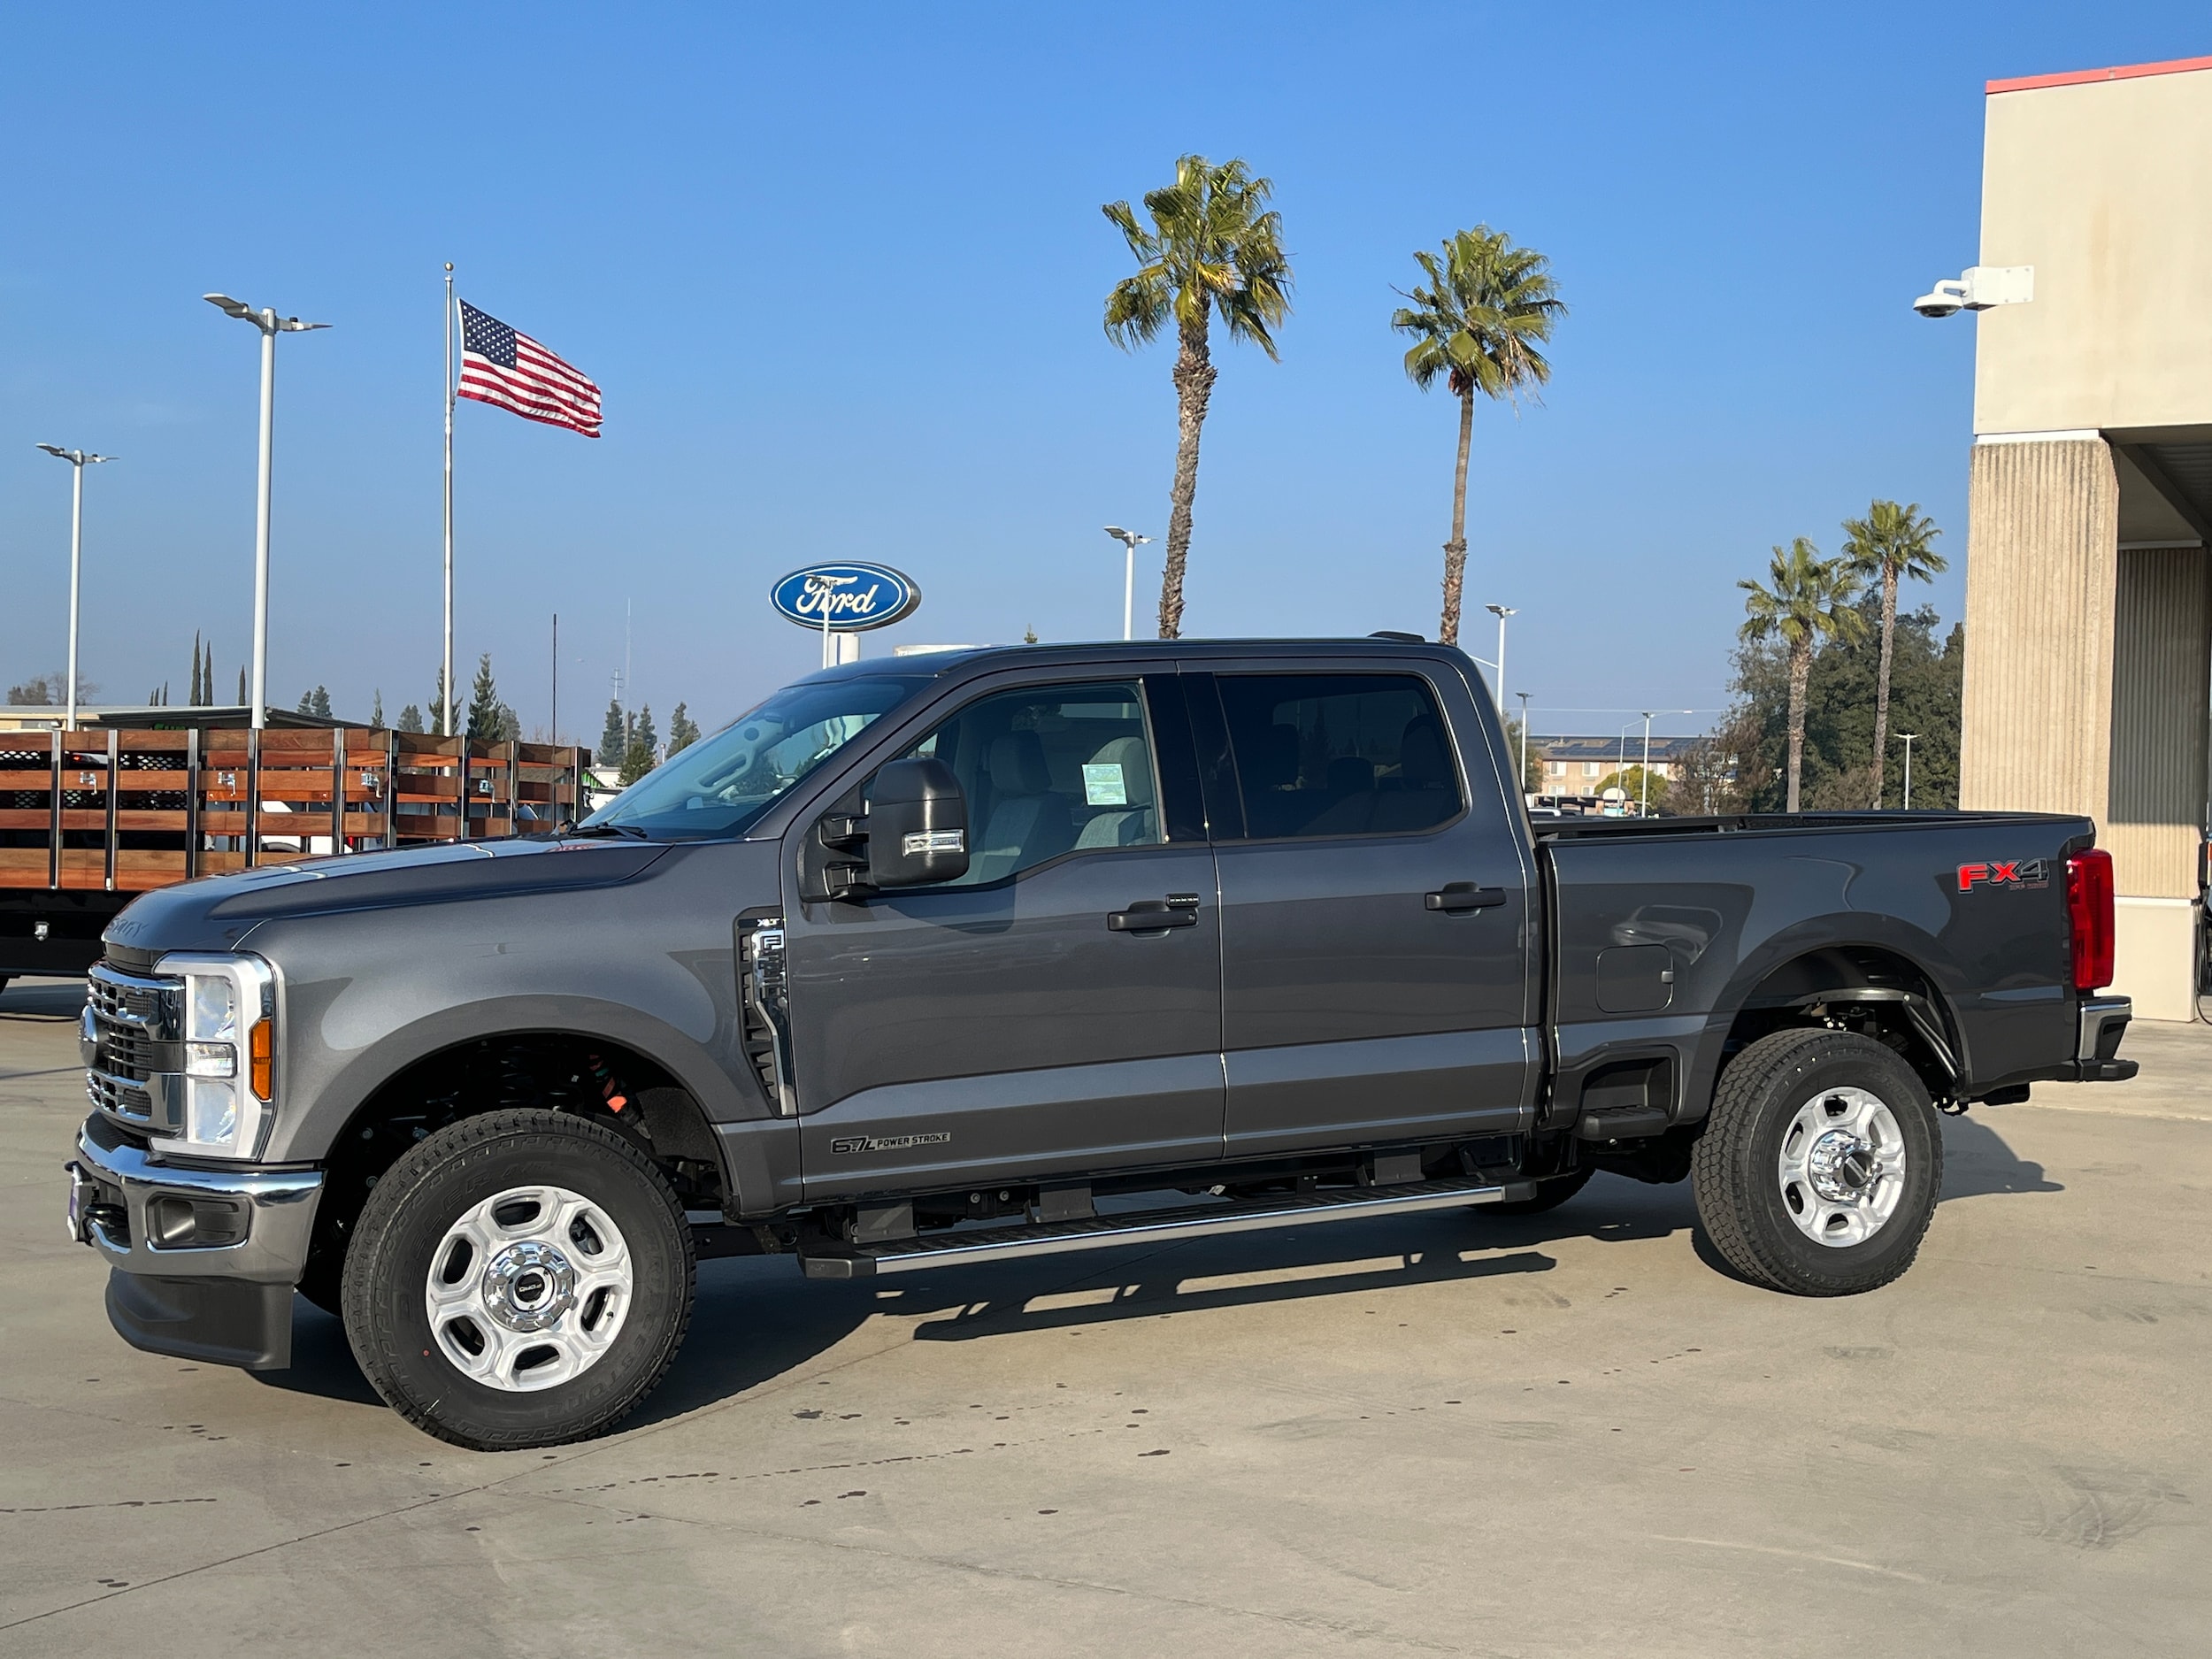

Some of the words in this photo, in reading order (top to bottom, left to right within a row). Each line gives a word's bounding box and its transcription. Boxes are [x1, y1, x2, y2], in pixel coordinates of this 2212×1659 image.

[796, 573, 879, 614] Ford
[1956, 857, 2049, 894] FX4
[877, 1136, 910, 1148] POWER
[911, 1133, 949, 1144] STROKE
